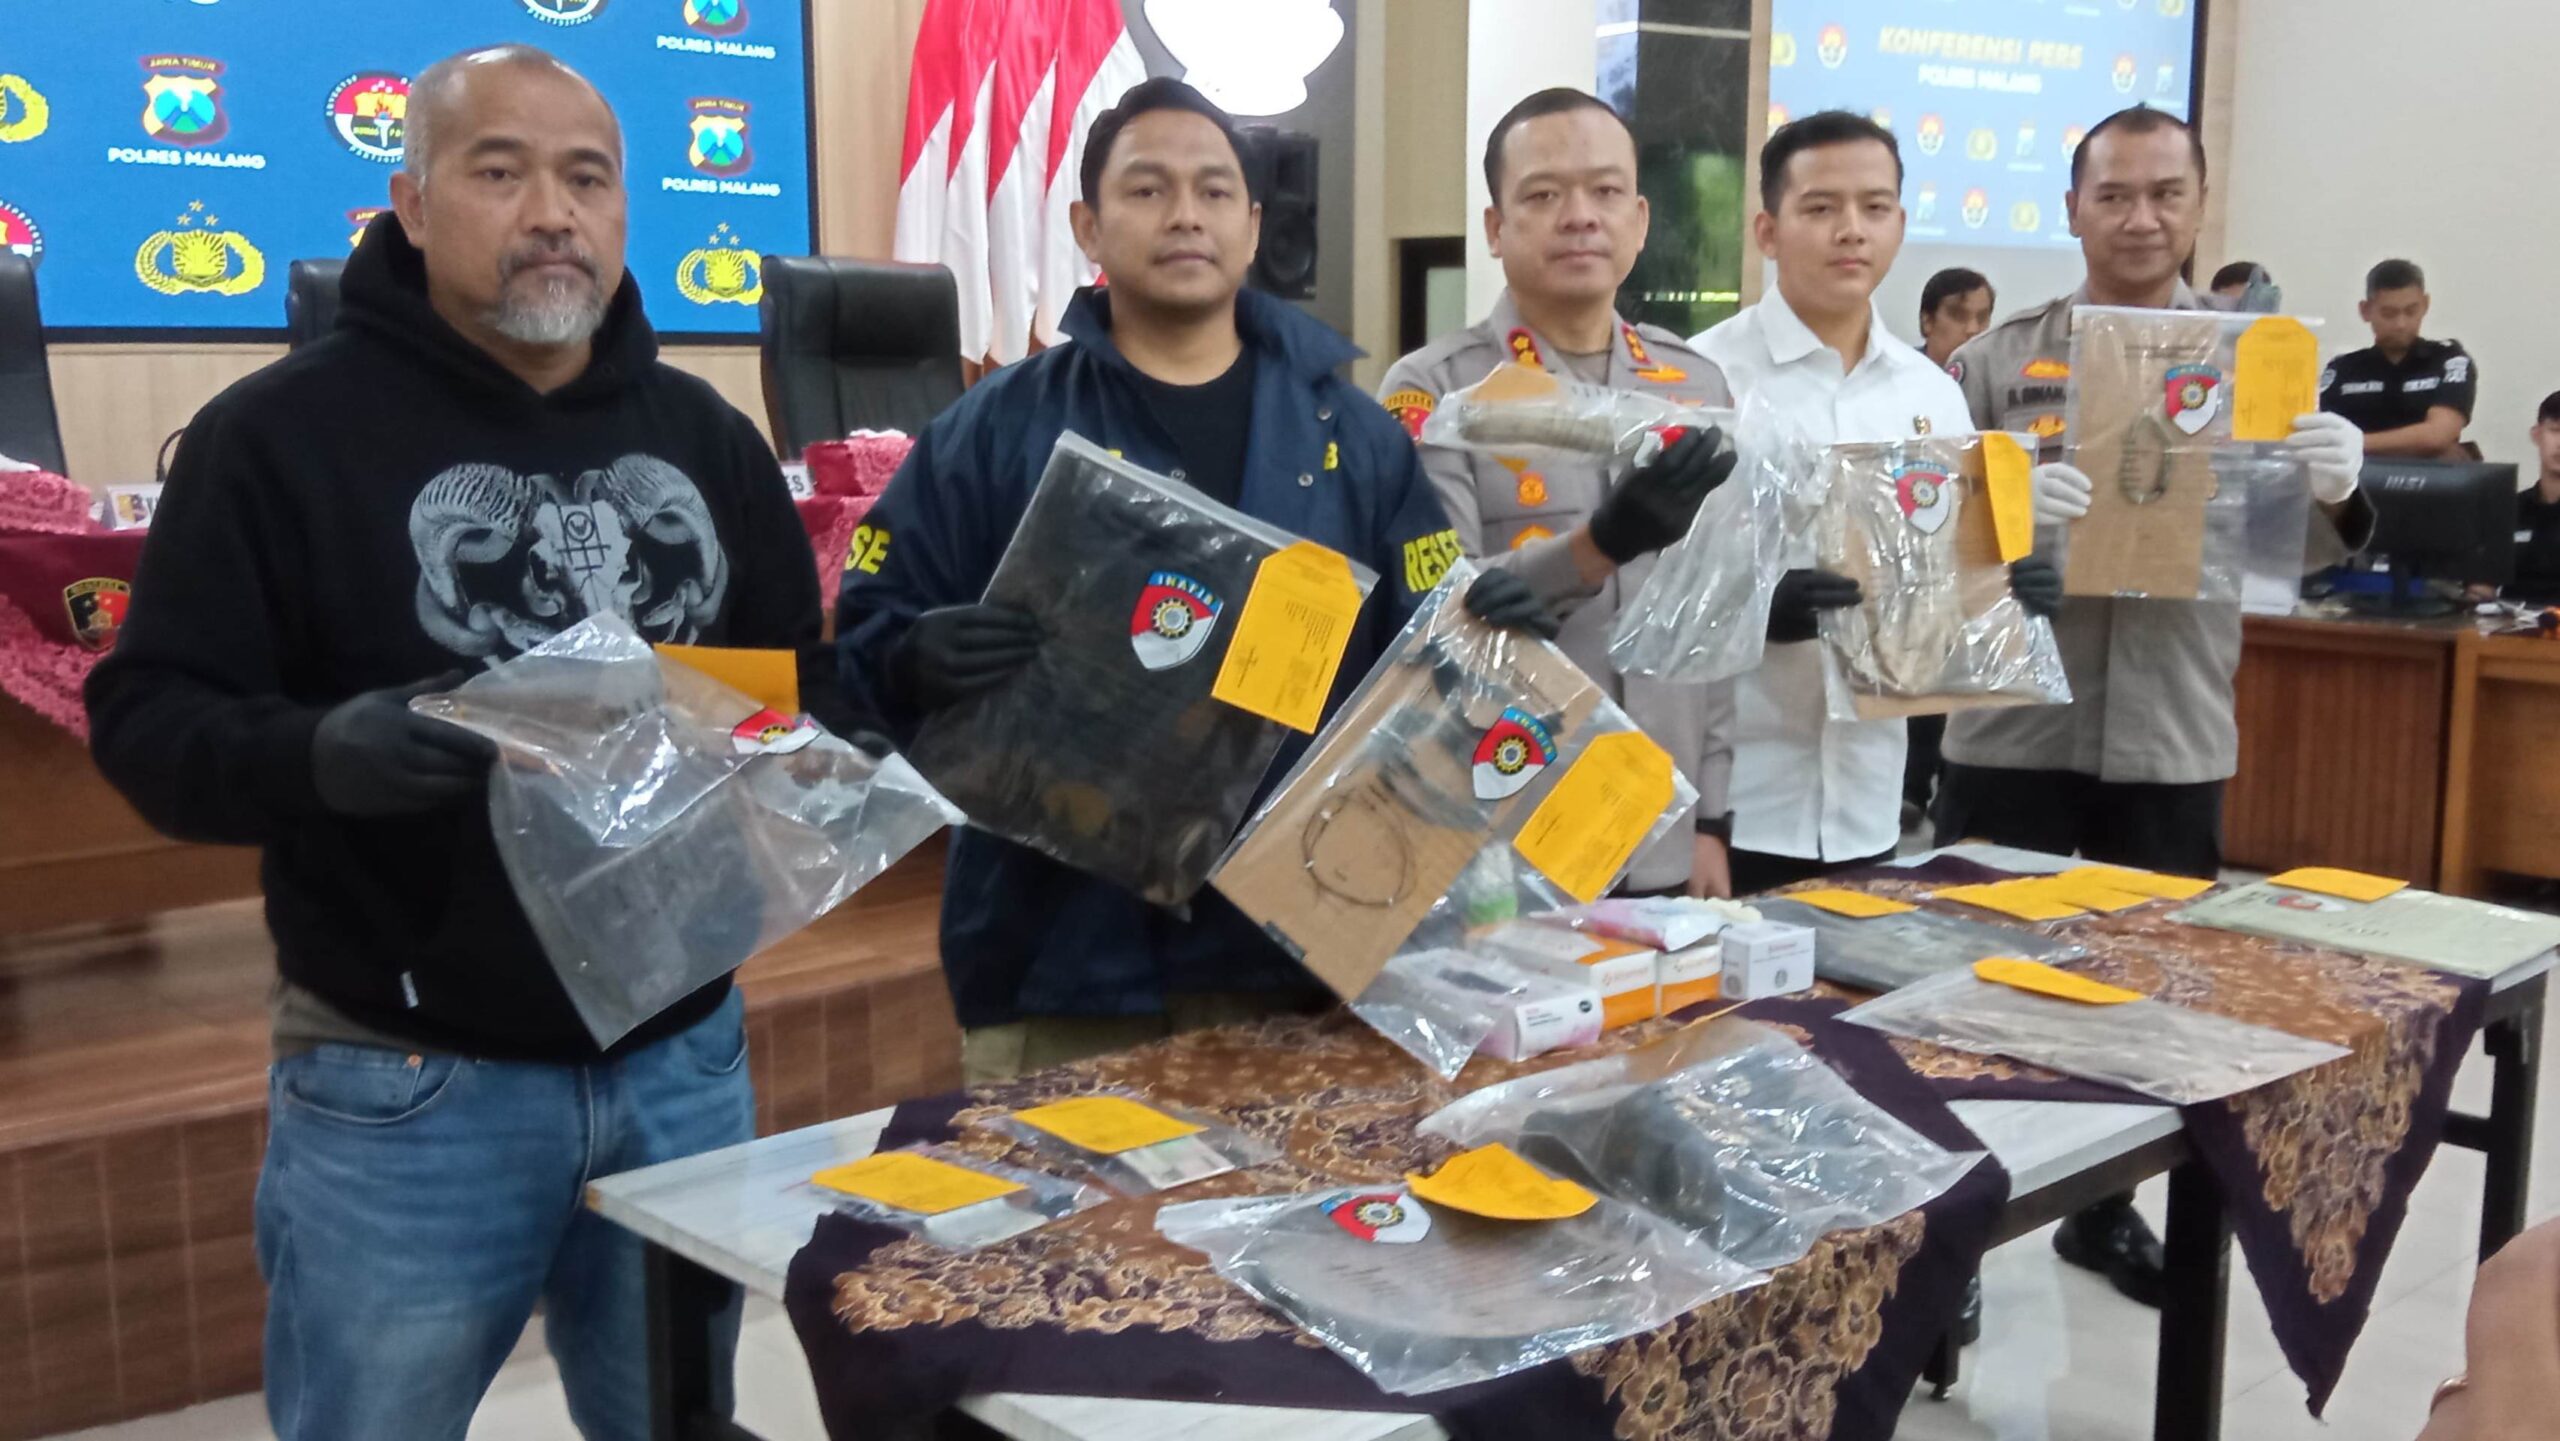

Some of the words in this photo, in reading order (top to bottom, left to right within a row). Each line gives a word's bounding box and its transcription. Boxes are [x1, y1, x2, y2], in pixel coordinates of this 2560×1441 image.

[656, 35, 713, 53] POLRES
[714, 40, 777, 59] MALANG
[1879, 26, 2022, 64] KONFERENSI
[2029, 40, 2083, 70] PERS
[108, 147, 181, 165] POLRES
[184, 151, 266, 170] MALANG
[662, 177, 718, 193] POLRES
[719, 181, 781, 197] MALANG
[1403, 528, 1463, 593] RESE
